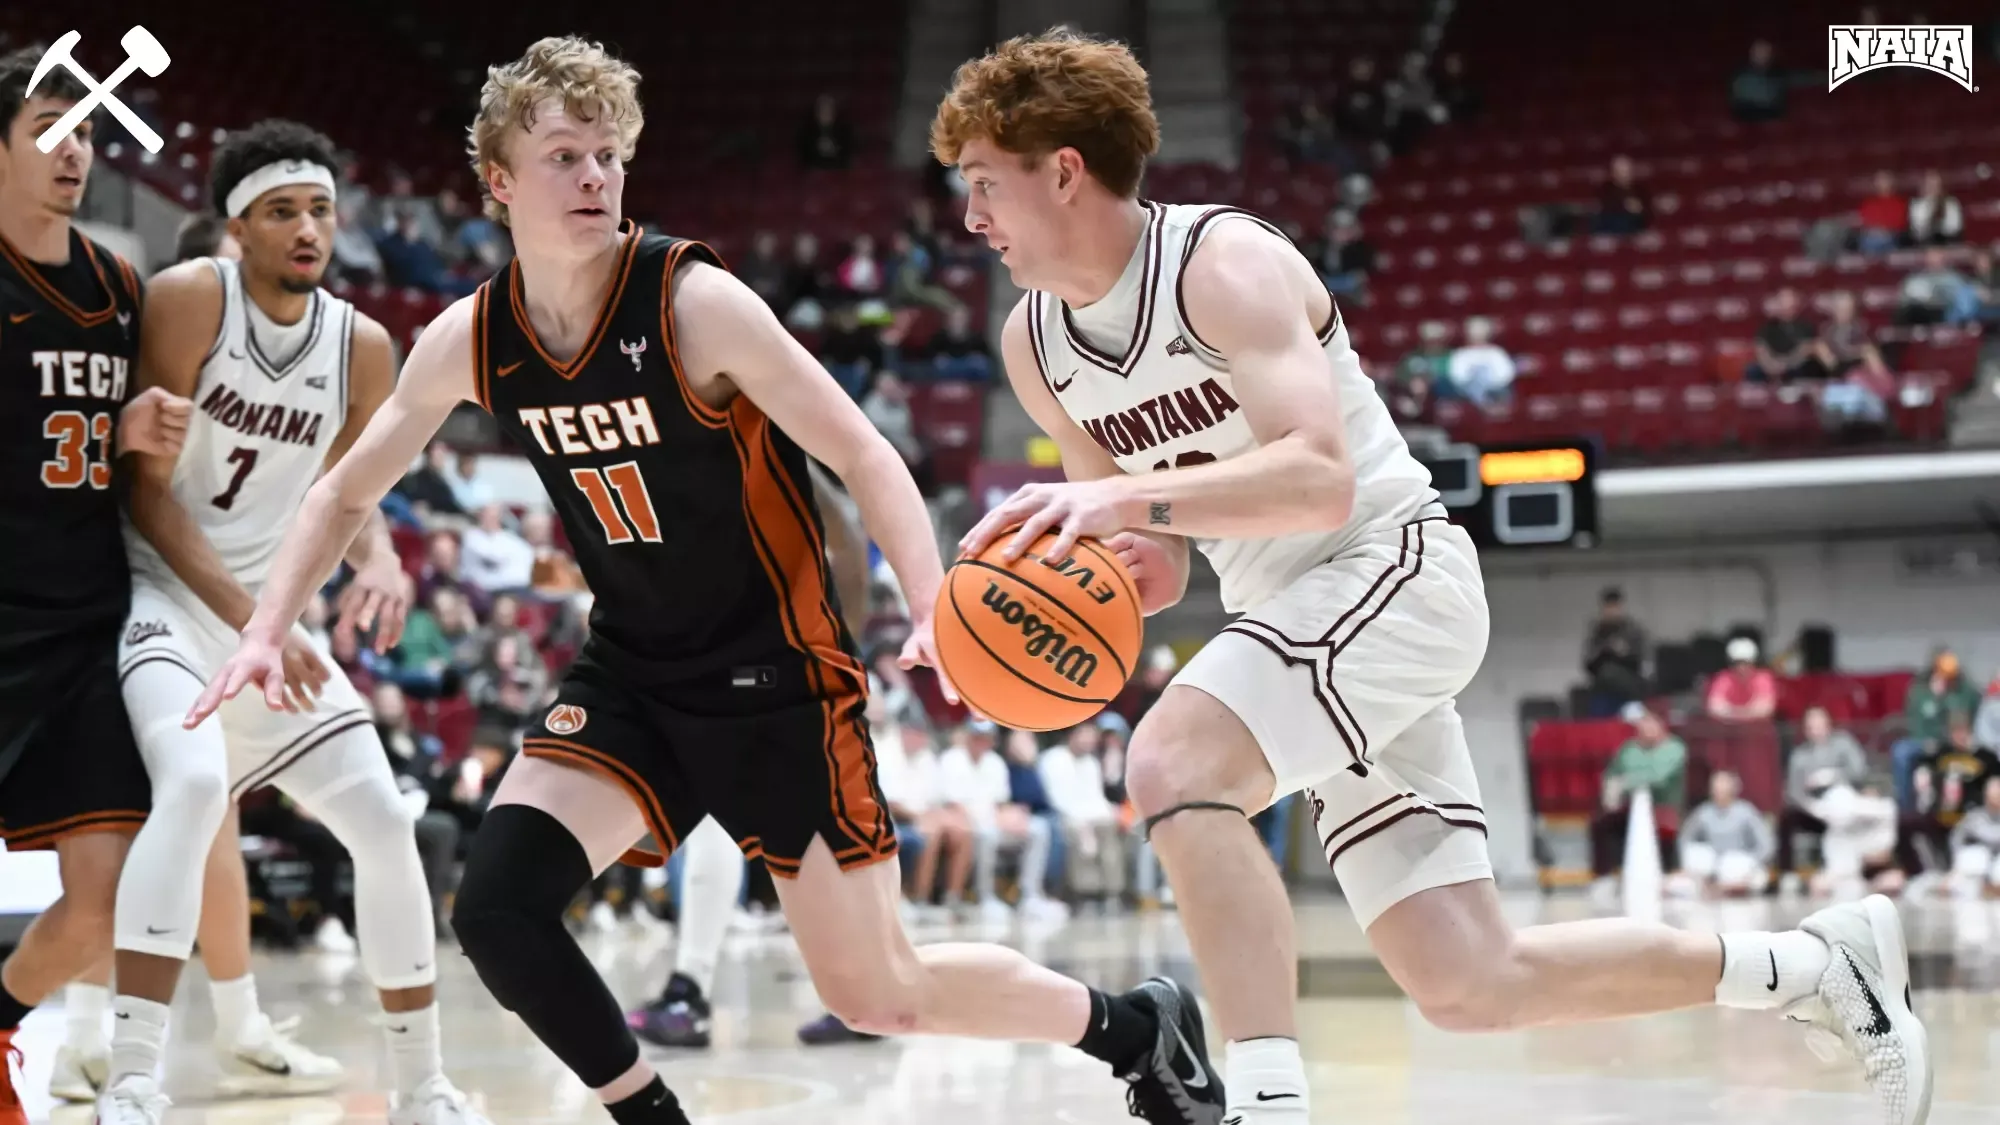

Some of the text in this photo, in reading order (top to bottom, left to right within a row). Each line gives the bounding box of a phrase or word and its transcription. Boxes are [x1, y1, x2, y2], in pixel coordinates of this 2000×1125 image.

[31, 350, 129, 401] TECH
[199, 382, 324, 448] MONANA
[517, 395, 662, 456] TECH
[1081, 377, 1240, 458] MONTANA
[210, 445, 259, 512] 7
[569, 459, 664, 545] 11
[981, 581, 1098, 689] Wilson
